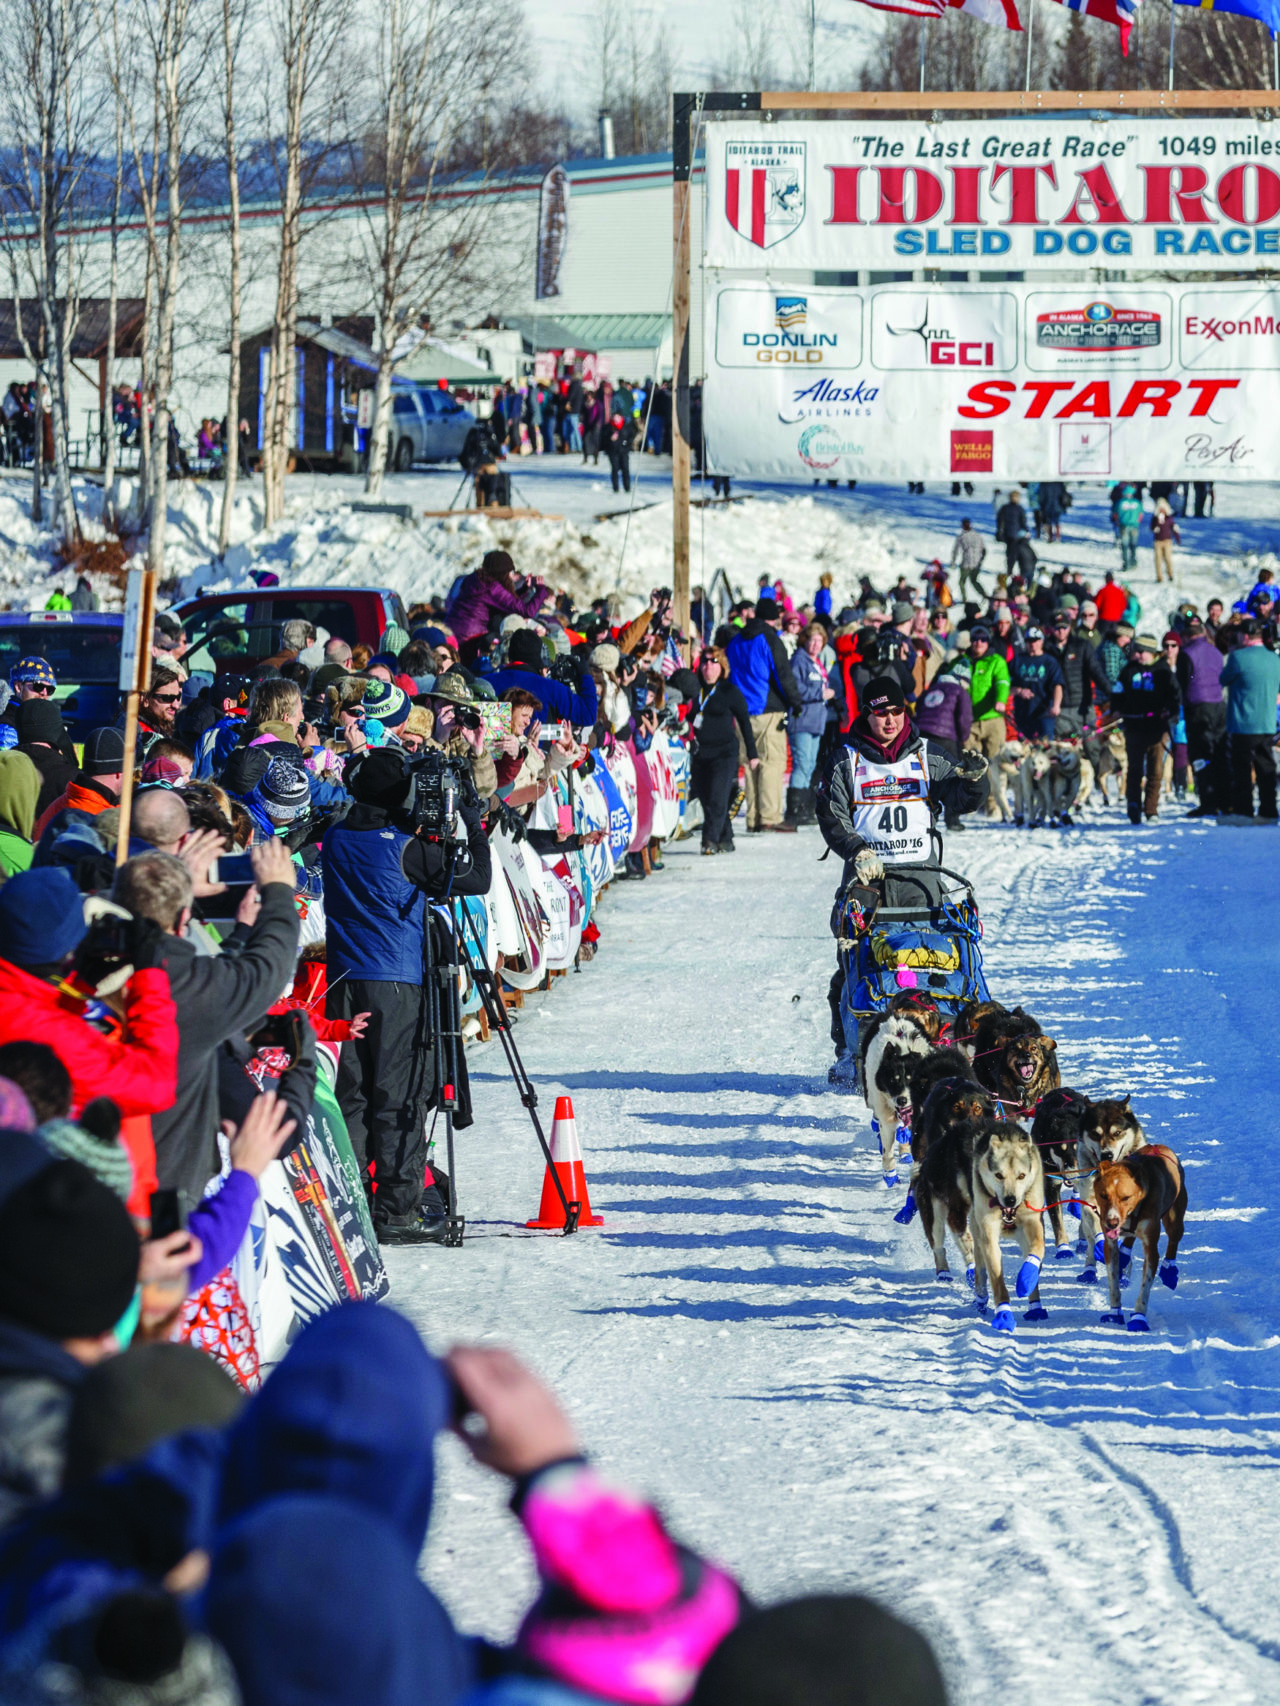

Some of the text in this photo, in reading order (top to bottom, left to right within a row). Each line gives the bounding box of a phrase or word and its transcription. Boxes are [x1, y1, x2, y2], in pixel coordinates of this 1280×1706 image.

[778, 145, 803, 155] TRAIL
[916, 135, 969, 158] Last
[982, 135, 1051, 158] Great
[1158, 136, 1217, 157] 1049
[893, 229, 1012, 257] SLED
[1033, 228, 1133, 257] DOG
[1041, 322, 1157, 336] ANCHORAGE
[743, 332, 838, 348] DONLIN
[756, 349, 823, 364] GOLD
[930, 341, 995, 367] GCI
[793, 377, 880, 403] Alaska
[957, 379, 1241, 419] START
[797, 408, 872, 416] AIRLINES
[877, 806, 908, 834] 40
[868, 839, 908, 851] DITAROD
